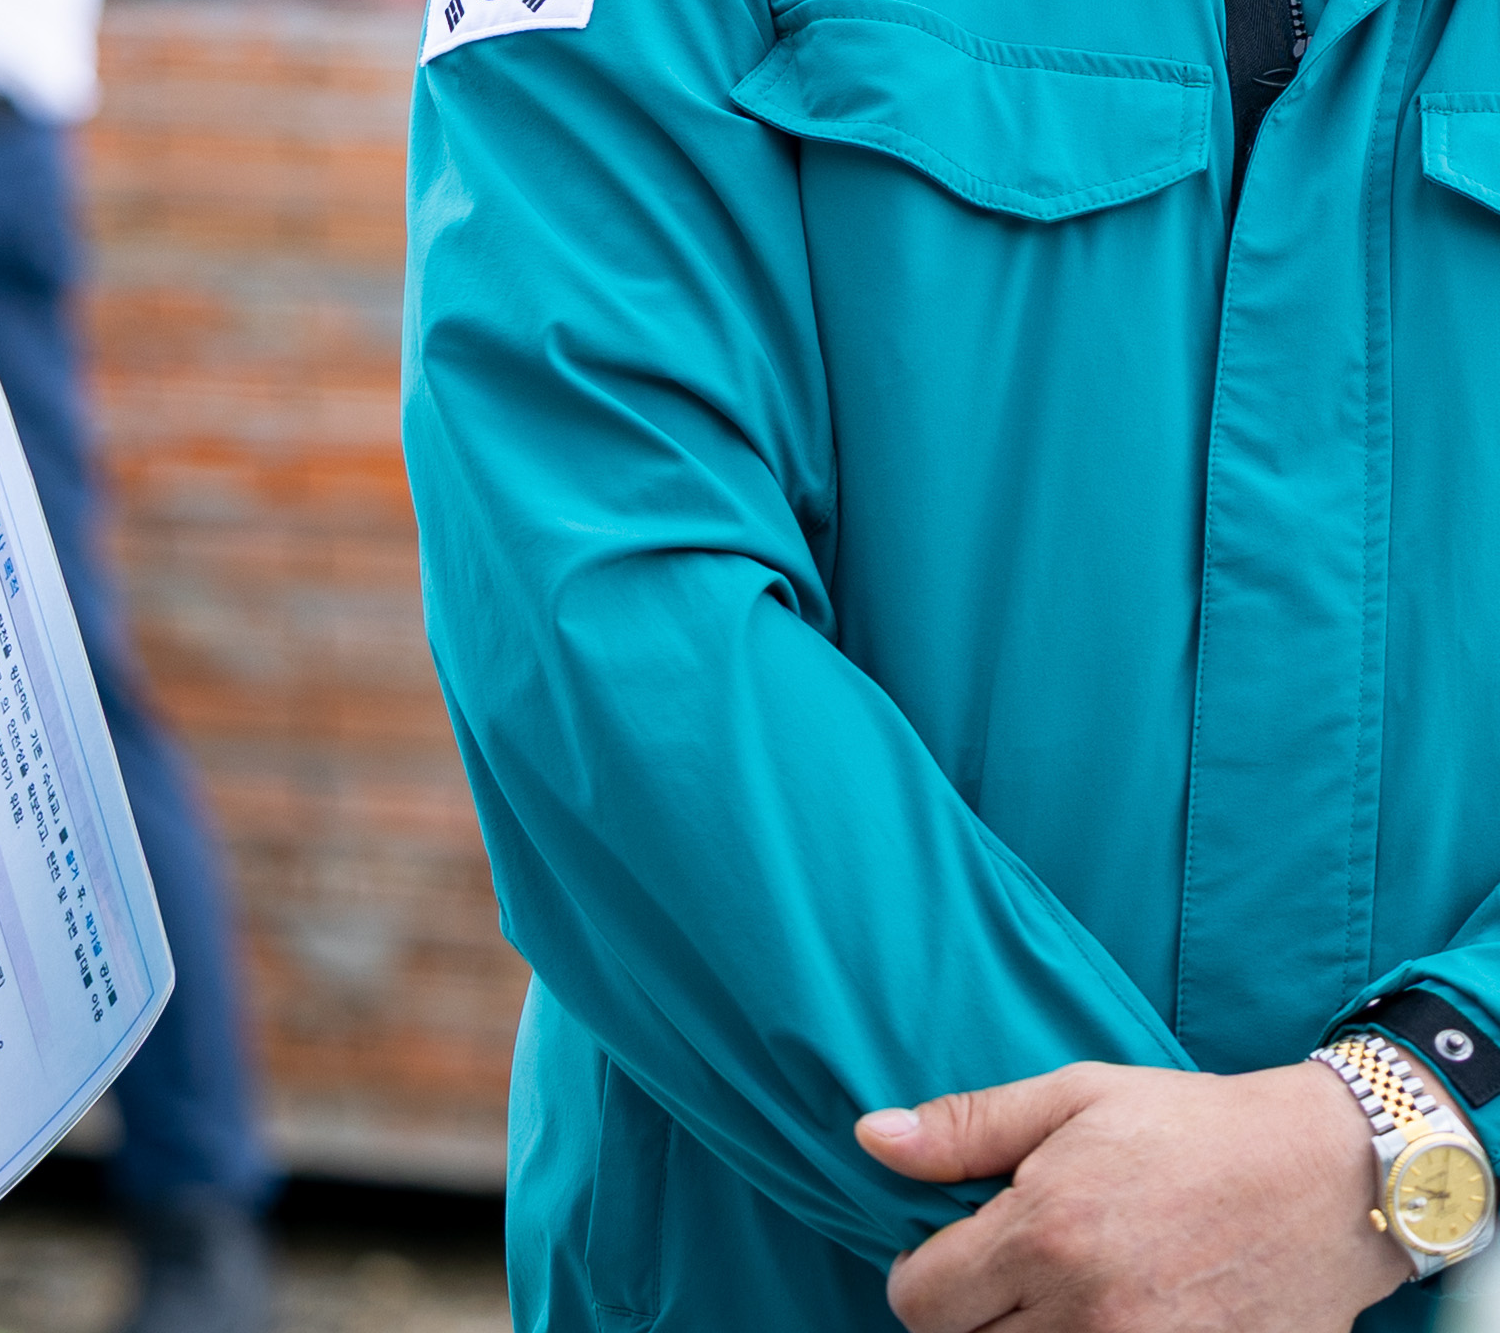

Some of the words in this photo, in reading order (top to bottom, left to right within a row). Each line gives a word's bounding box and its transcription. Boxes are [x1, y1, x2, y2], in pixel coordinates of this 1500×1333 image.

[2, 556, 20, 599] 목적
[6, 717, 30, 779] 안전성을
[26, 781, 50, 848] 확보하고,
[45, 849, 62, 883] 탄천
[56, 884, 68, 905] 및
[63, 906, 79, 941] 주변
[73, 942, 94, 990] 일대를
[90, 992, 104, 1023] 이용
[8, 791, 24, 829] 위함.
[9, 663, 31, 725] 횡단하는
[64, 848, 80, 882] 철거
[76, 883, 87, 909] 후,
[84, 910, 103, 958] 재가설
[98, 960, 118, 1008] 공사를
